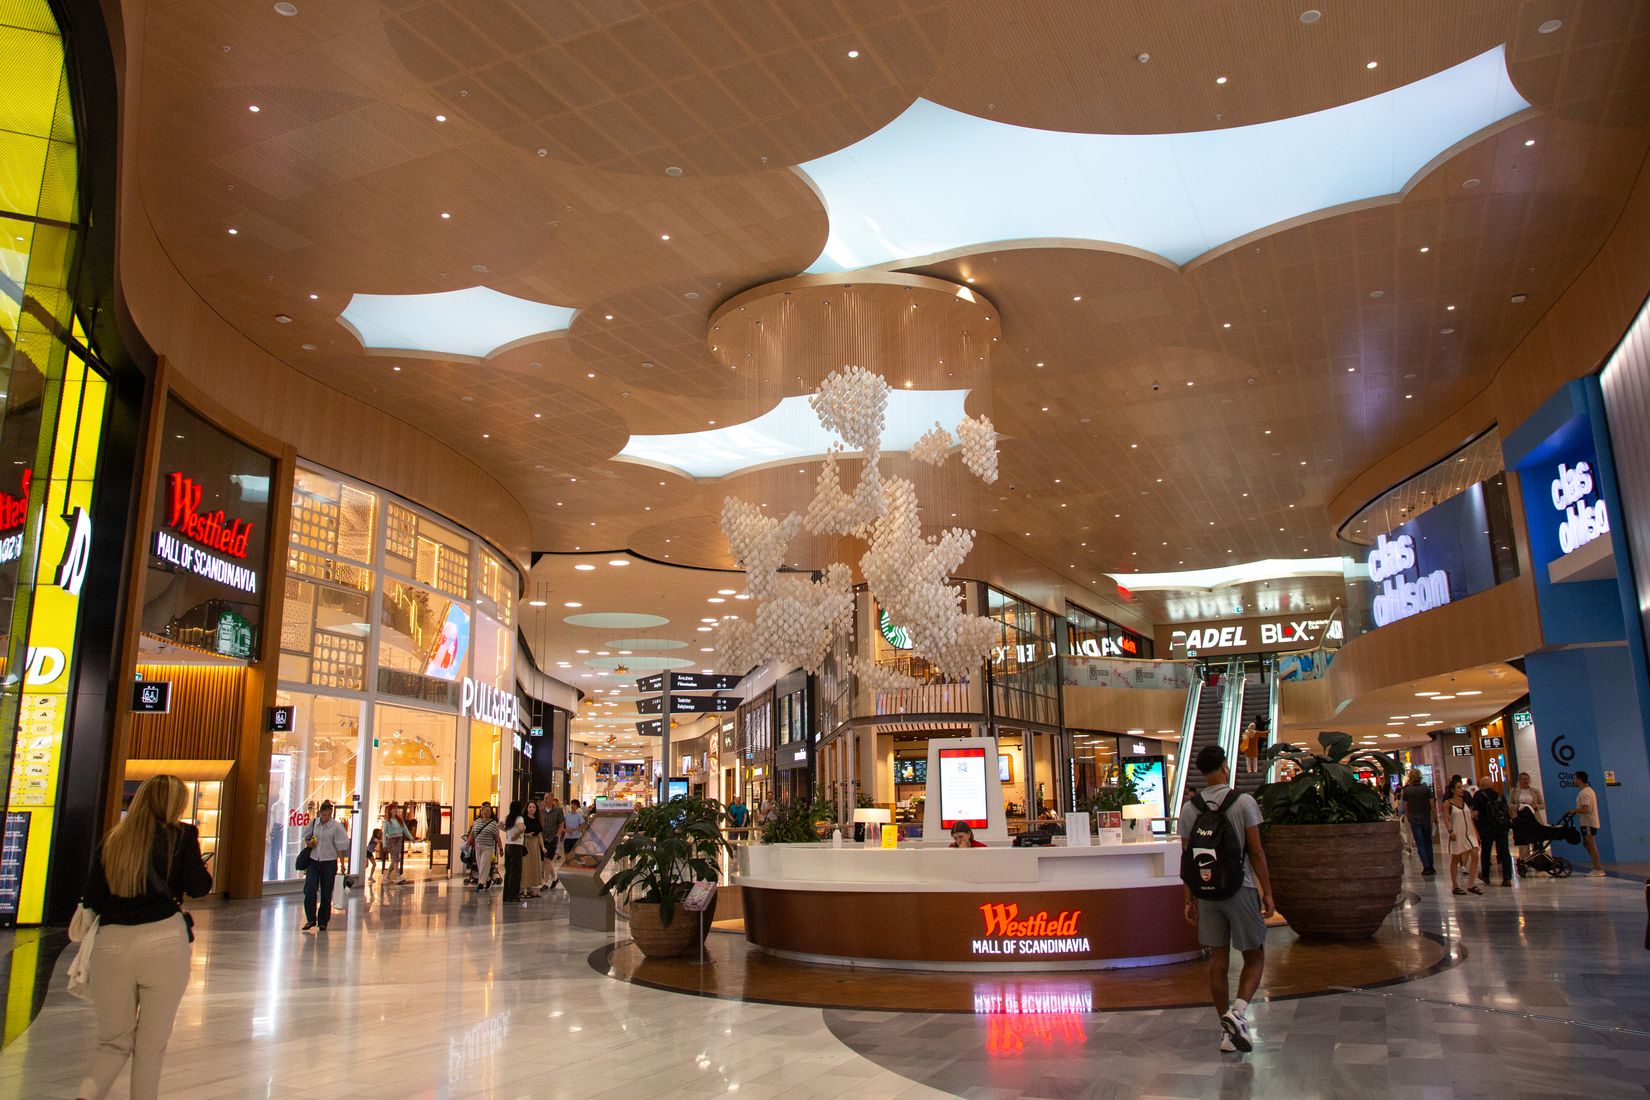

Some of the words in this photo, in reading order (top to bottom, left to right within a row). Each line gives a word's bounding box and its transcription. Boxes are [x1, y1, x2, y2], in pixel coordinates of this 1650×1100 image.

[169, 472, 253, 558] Westfield
[1559, 500, 1609, 554] ohlso
[157, 532, 179, 565] MALL
[181, 546, 194, 570] OF
[194, 550, 256, 593] SCANDINAVIA
[1373, 570, 1450, 627] ohlson
[462, 676, 520, 732] PULL&BEA
[972, 940, 1001, 954] MALL
[1003, 939, 1017, 954] OF
[1019, 938, 1091, 954] SCANDINAVIA
[979, 902, 1082, 937] Westfield
